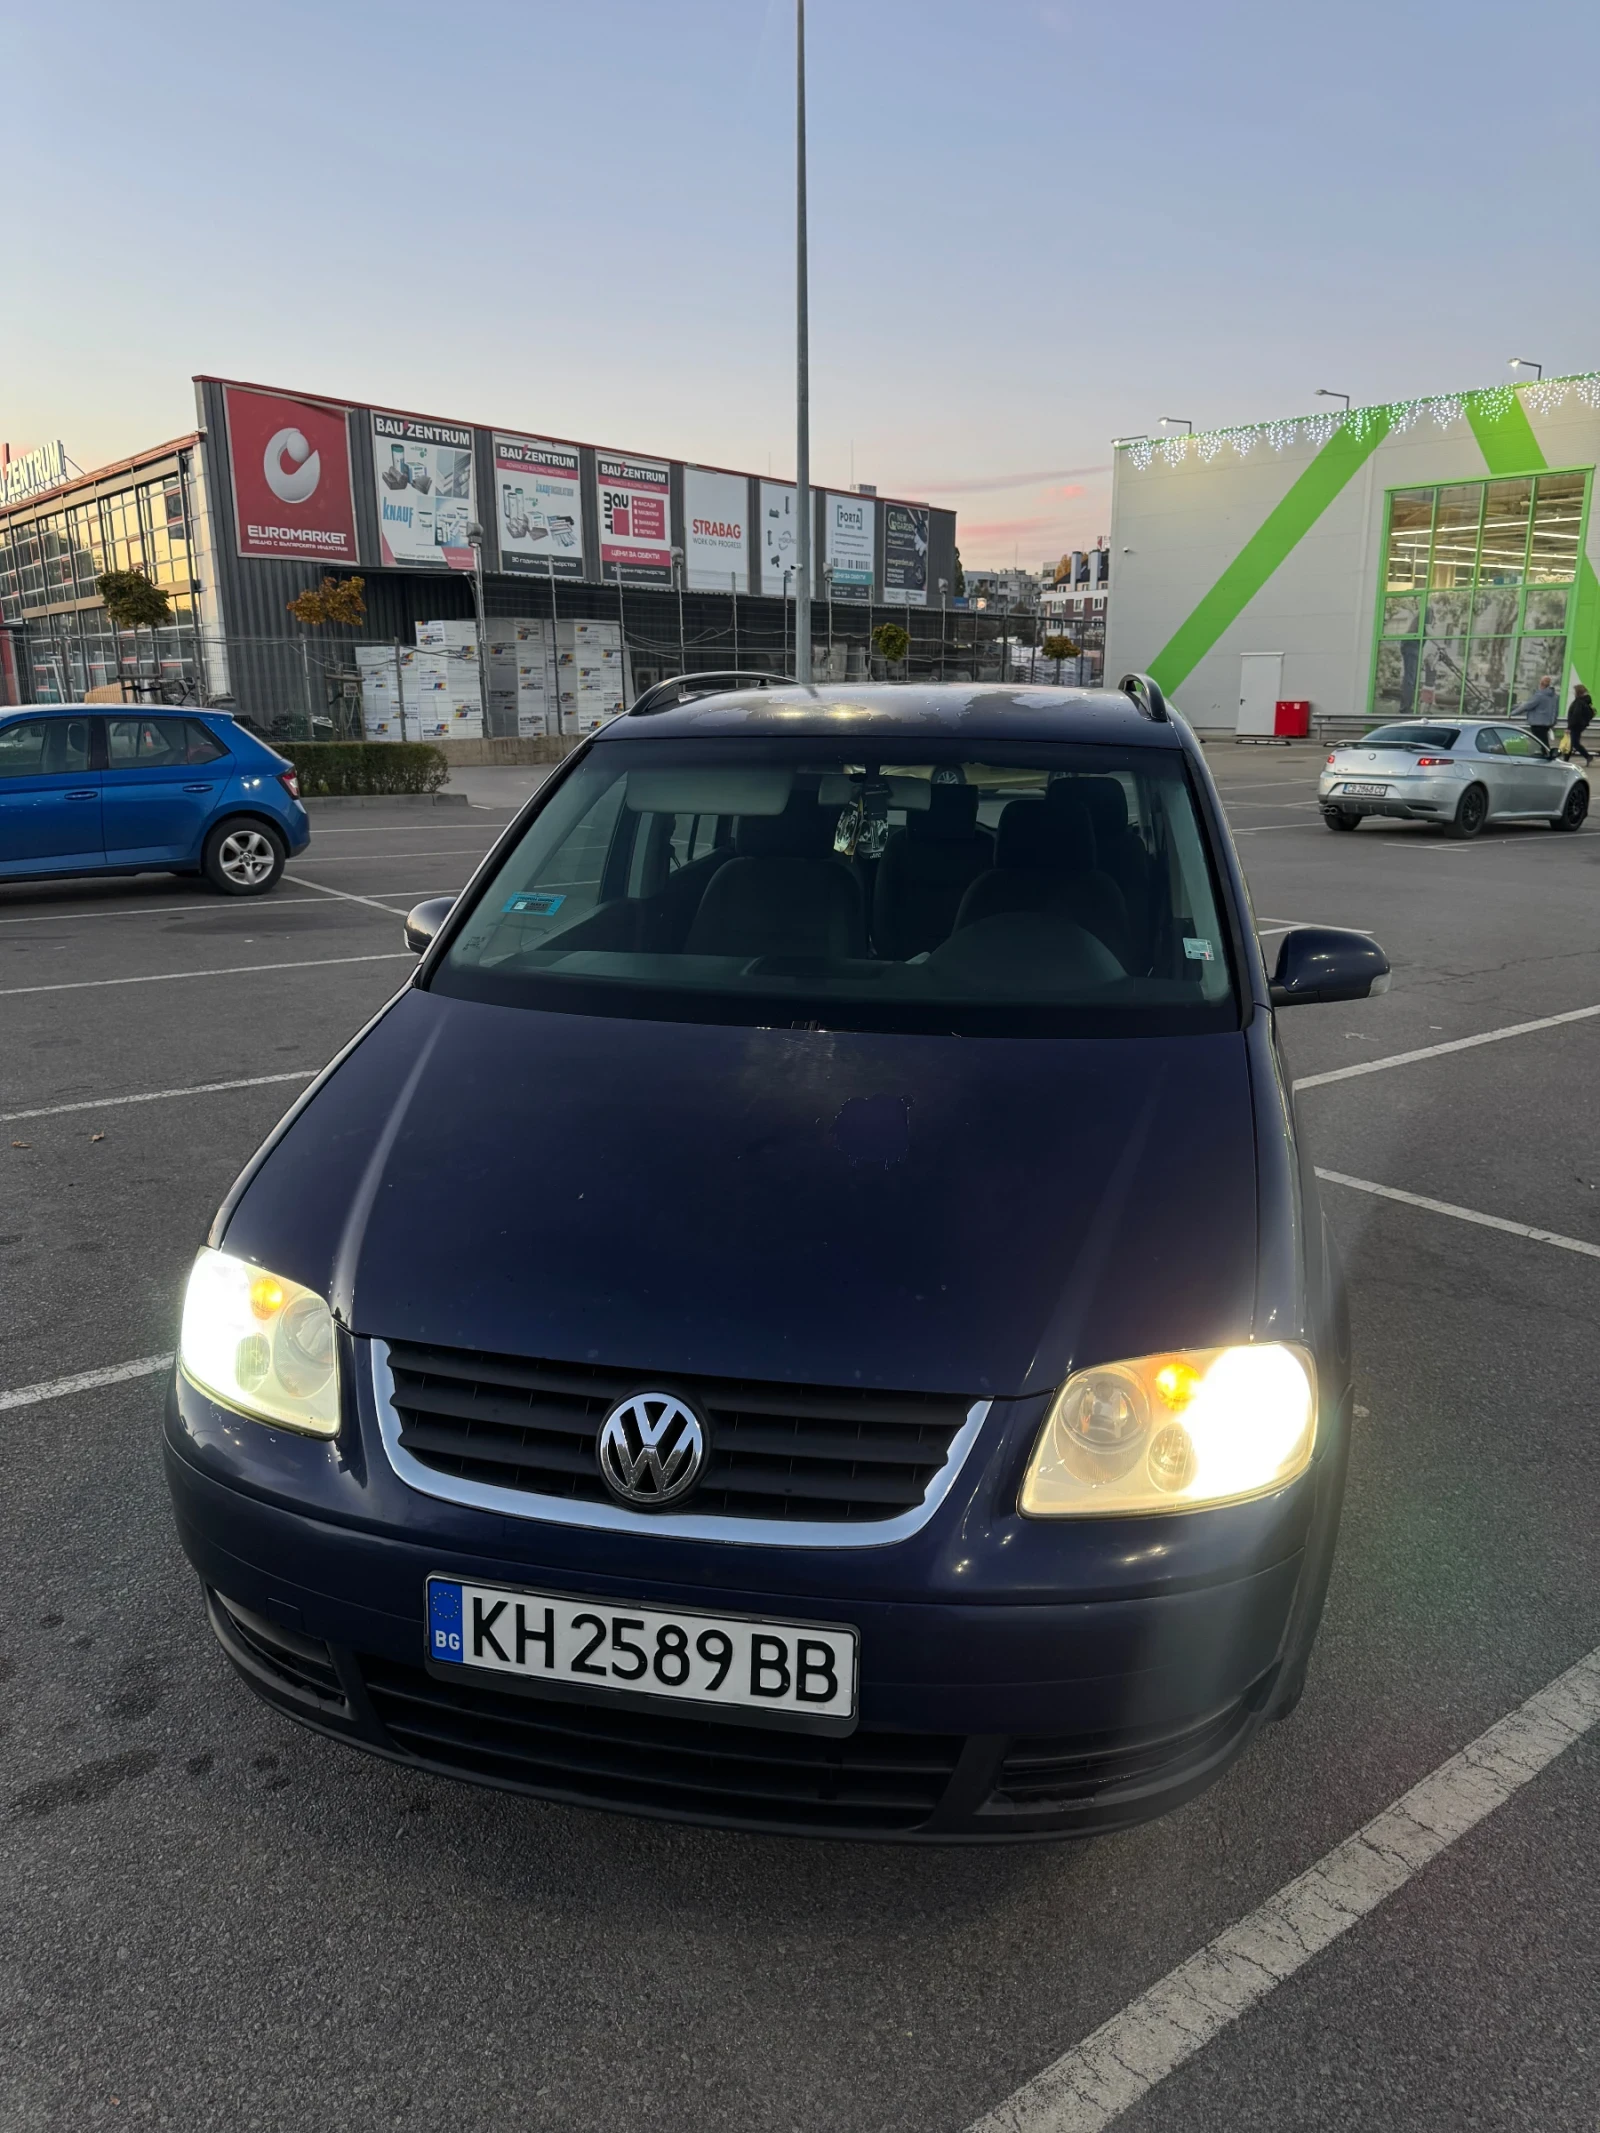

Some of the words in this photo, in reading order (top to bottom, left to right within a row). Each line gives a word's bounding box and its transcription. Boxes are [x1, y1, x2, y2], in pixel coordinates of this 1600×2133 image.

[376, 417, 404, 435] BAU
[407, 423, 470, 445] ZENTRUM
[7, 440, 63, 495] ZENTRUM
[500, 446, 523, 460] BAU
[525, 451, 575, 468] ZENTRUM
[601, 463, 621, 476] BAU
[623, 467, 666, 483] ZENTRUM
[383, 496, 414, 528] KNAUF
[840, 512, 861, 523] PORTA
[247, 524, 347, 545] EUROMARKET
[692, 518, 741, 539] STRABAG
[692, 537, 708, 545] WORK
[709, 538, 717, 546] ON
[718, 540, 742, 549] PROGRESS
[435, 1629, 460, 1650] BG
[473, 1596, 555, 1669] KH
[570, 1613, 734, 1691] 2589
[750, 1633, 838, 1703] BB
